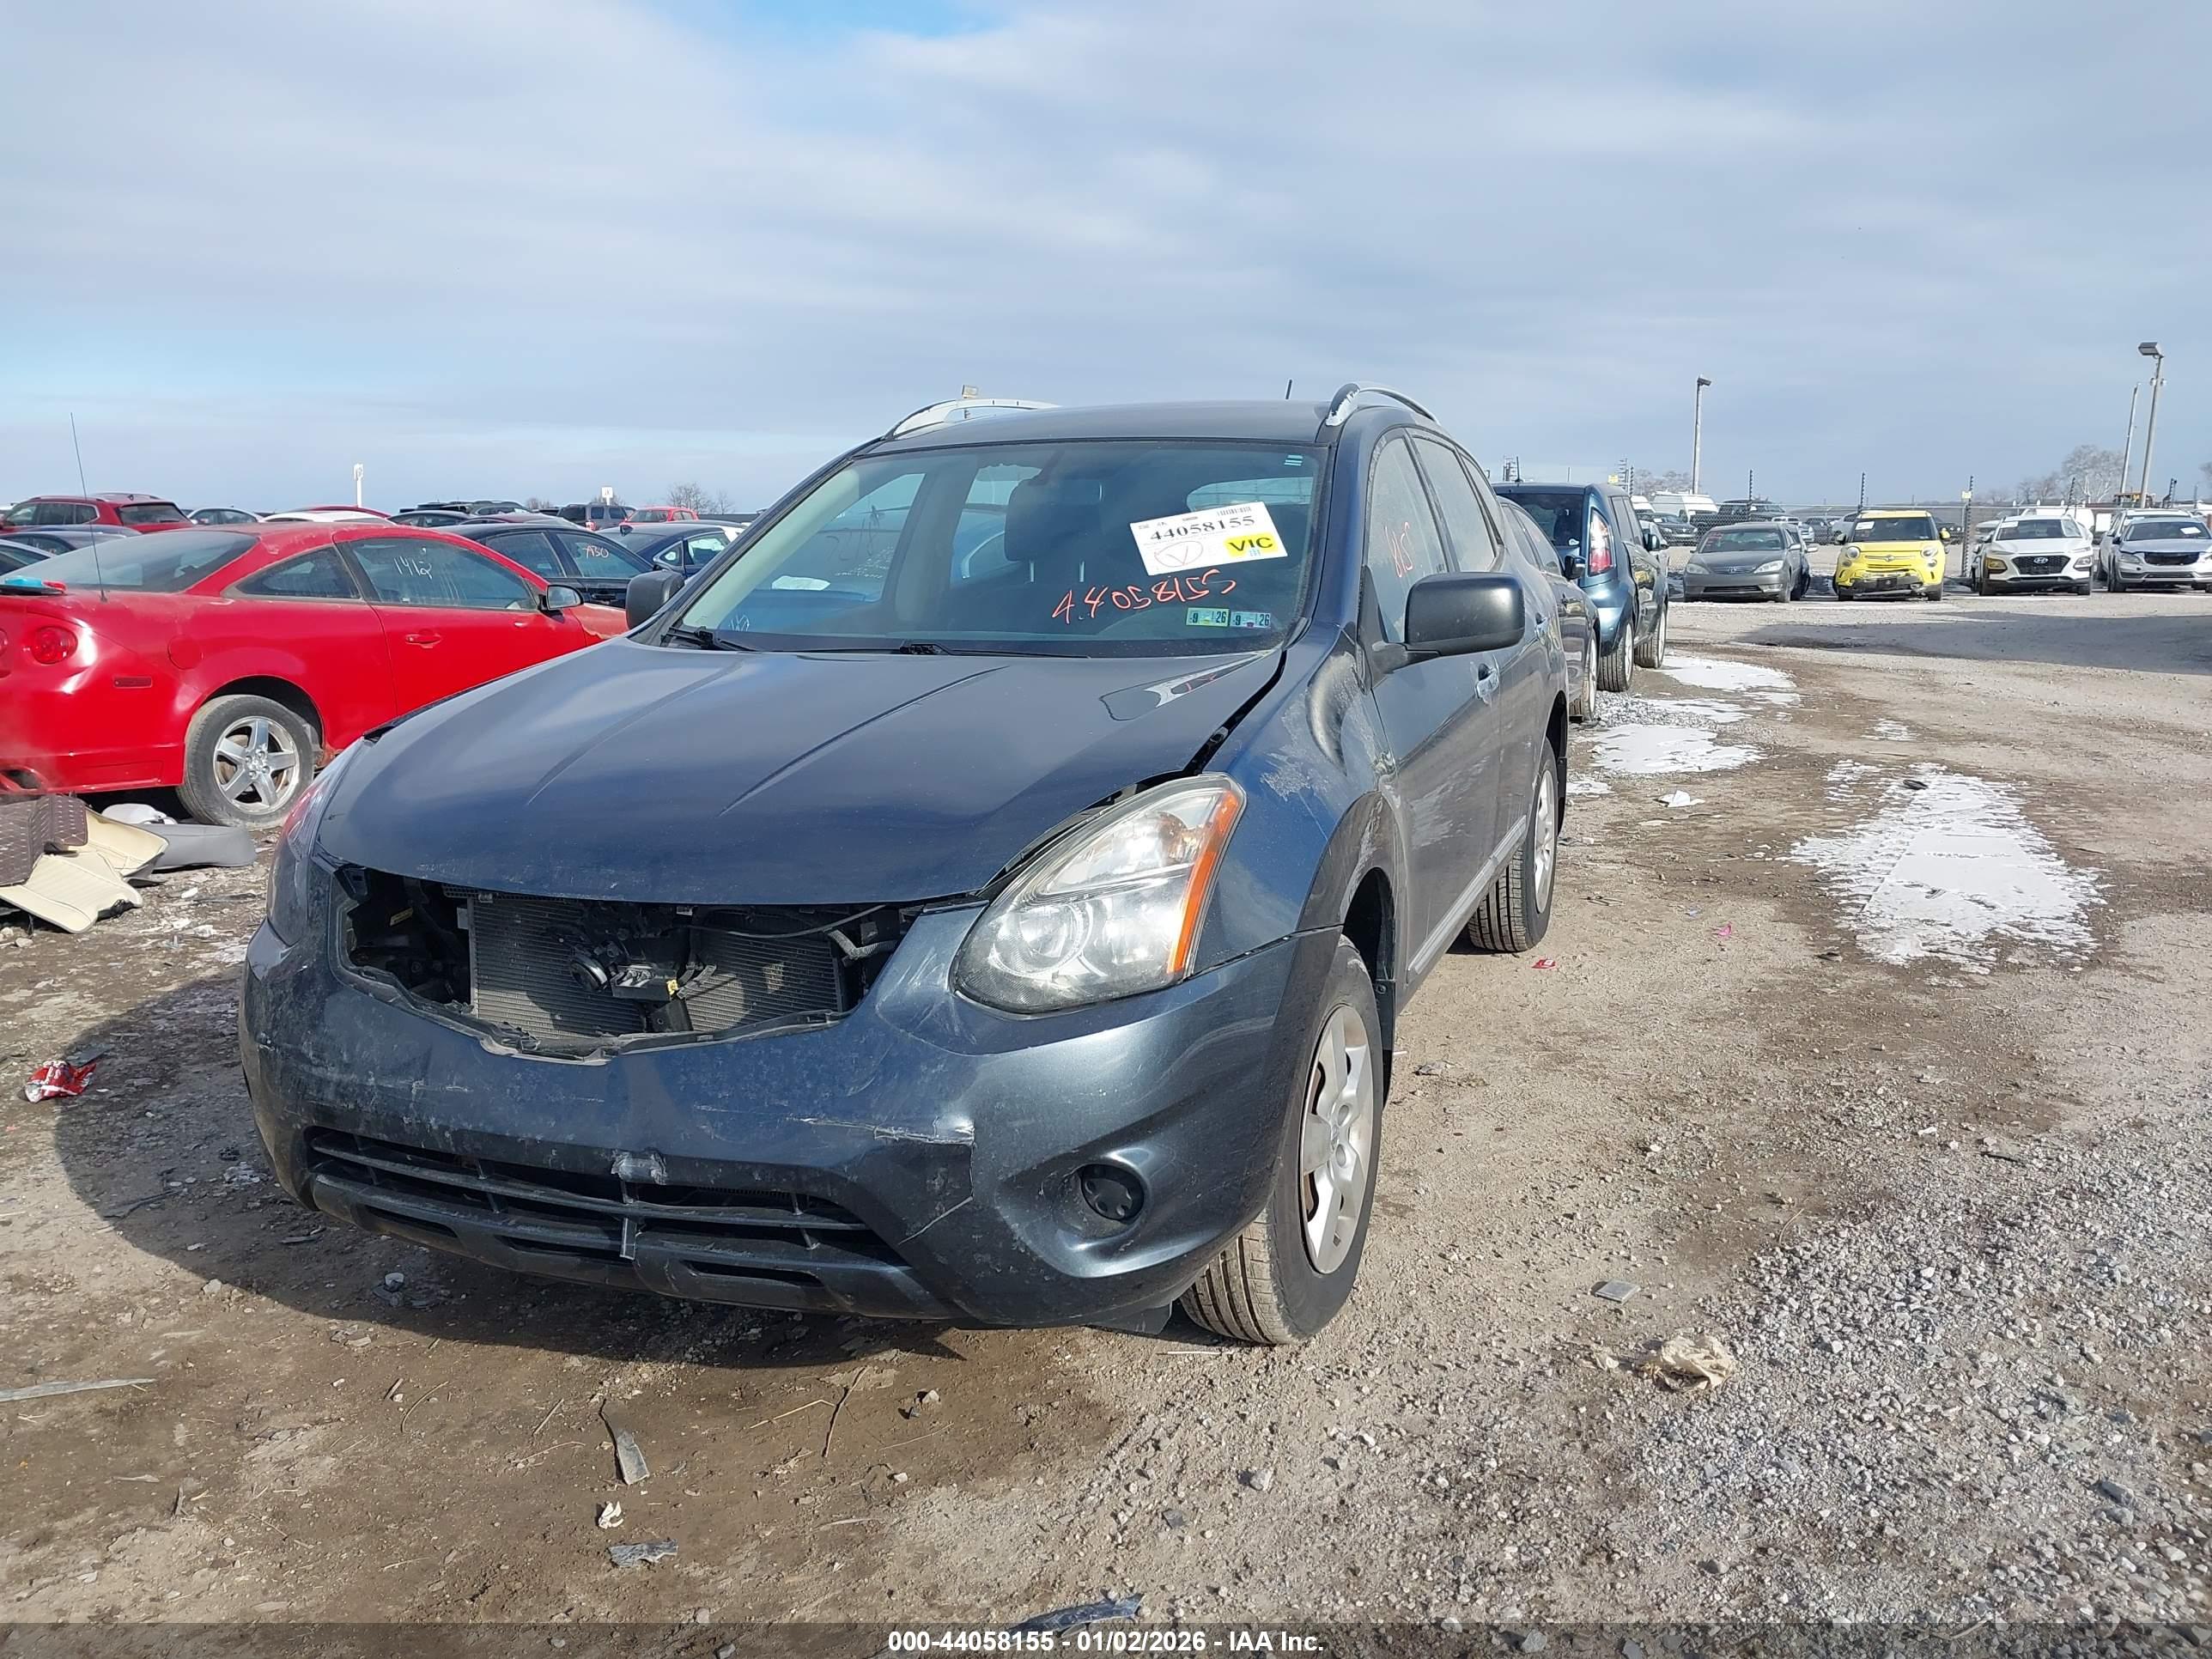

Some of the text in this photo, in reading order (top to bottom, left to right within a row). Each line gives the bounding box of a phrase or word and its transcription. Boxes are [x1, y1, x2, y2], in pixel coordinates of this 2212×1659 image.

[1150, 515, 1255, 540] 44058155
[1228, 537, 1274, 552] VIC
[1051, 568, 1237, 624] 44058155
[1216, 611, 1227, 623] 26
[1259, 613, 1270, 626] 26
